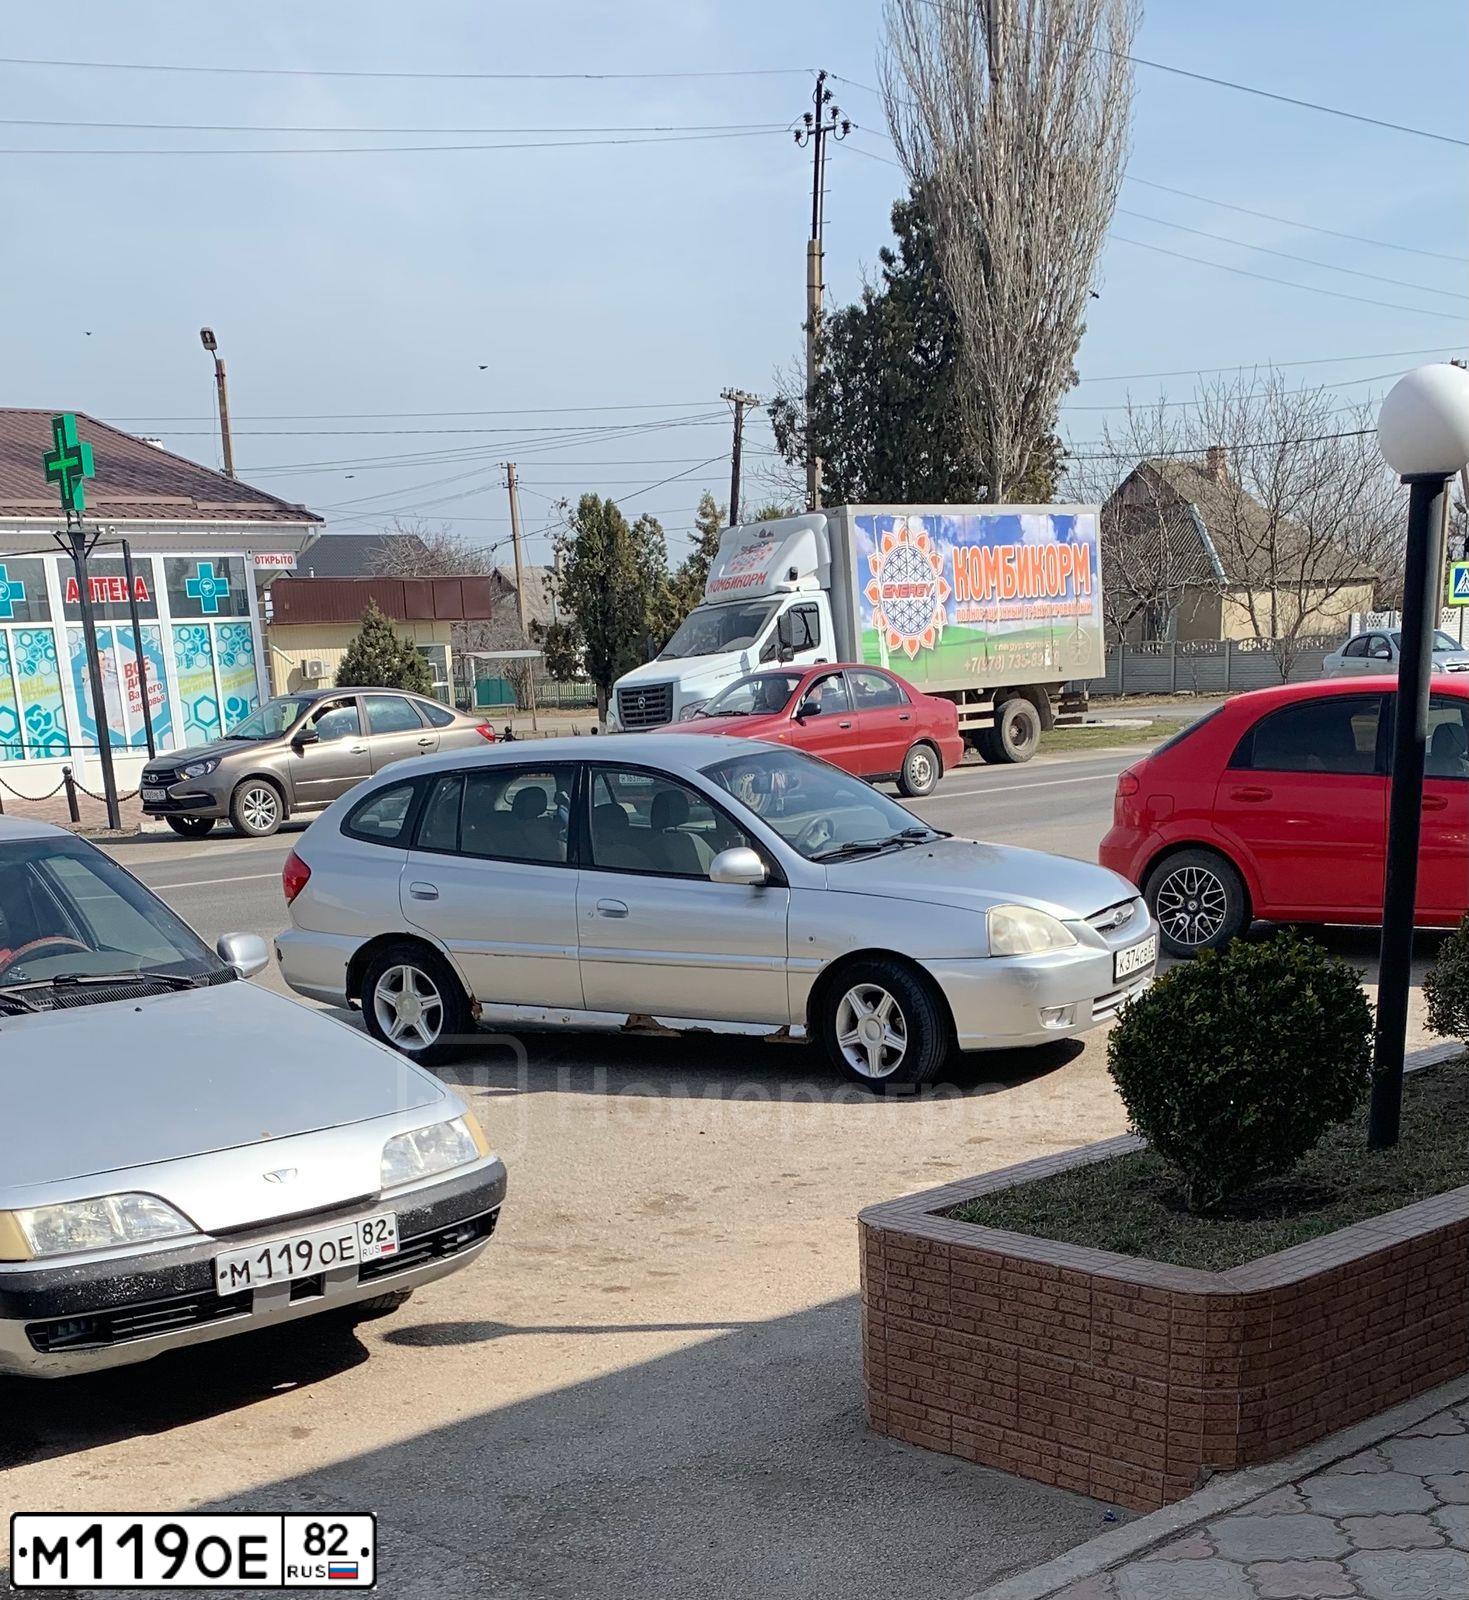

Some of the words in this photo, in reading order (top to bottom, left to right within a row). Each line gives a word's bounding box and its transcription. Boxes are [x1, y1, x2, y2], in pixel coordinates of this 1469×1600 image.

[254, 555, 293, 565] ОТКРЫТО
[952, 543, 1091, 602] КОМБИКОРМ
[707, 572, 769, 594] КОМБИКОРМ
[882, 582, 934, 599] ENERGY
[129, 683, 163, 702] Ваего
[131, 694, 166, 713] здоовья
[230, 1236, 354, 1287] М119ОЕ
[362, 1218, 388, 1245] 82
[362, 1245, 381, 1256] RUS
